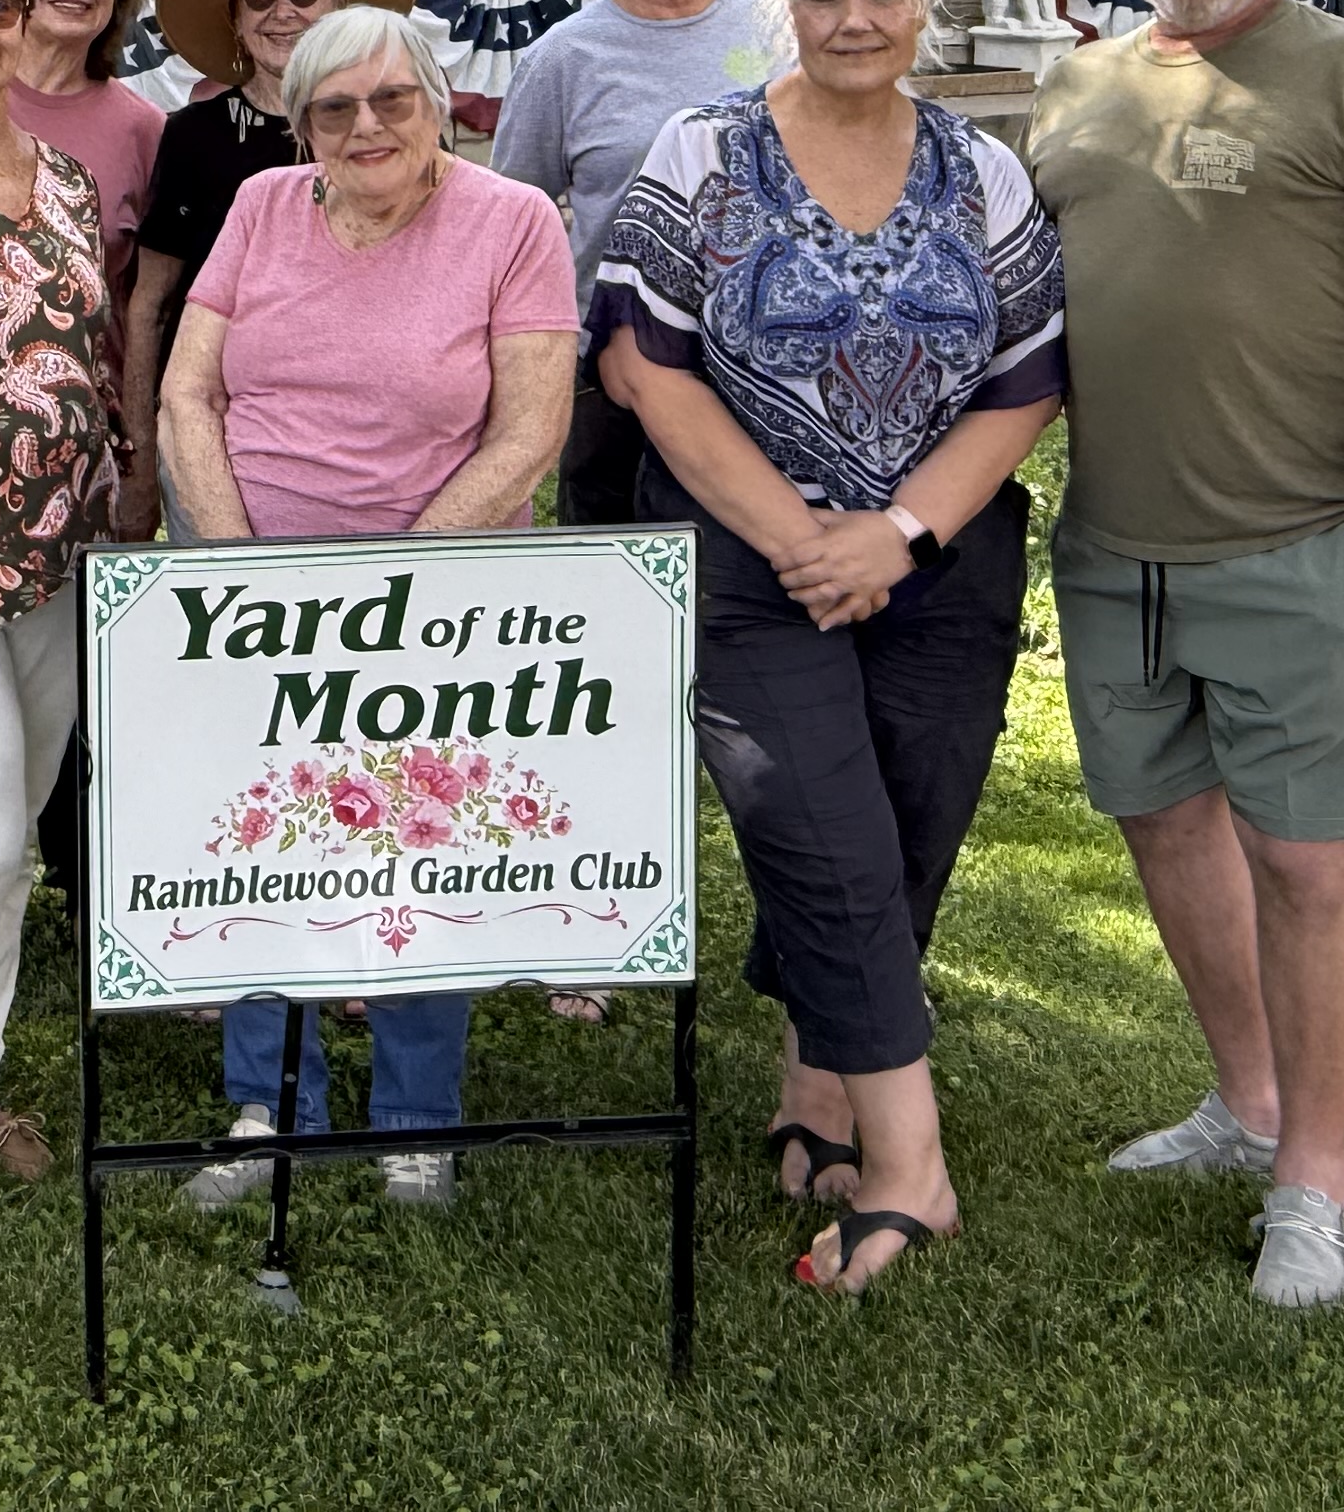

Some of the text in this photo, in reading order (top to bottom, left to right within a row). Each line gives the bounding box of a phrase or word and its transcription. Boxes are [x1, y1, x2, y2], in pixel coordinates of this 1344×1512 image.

[170, 573, 587, 660] Yard of the
[259, 657, 616, 747] Month
[127, 851, 663, 913] Ramblewood Garden Club
